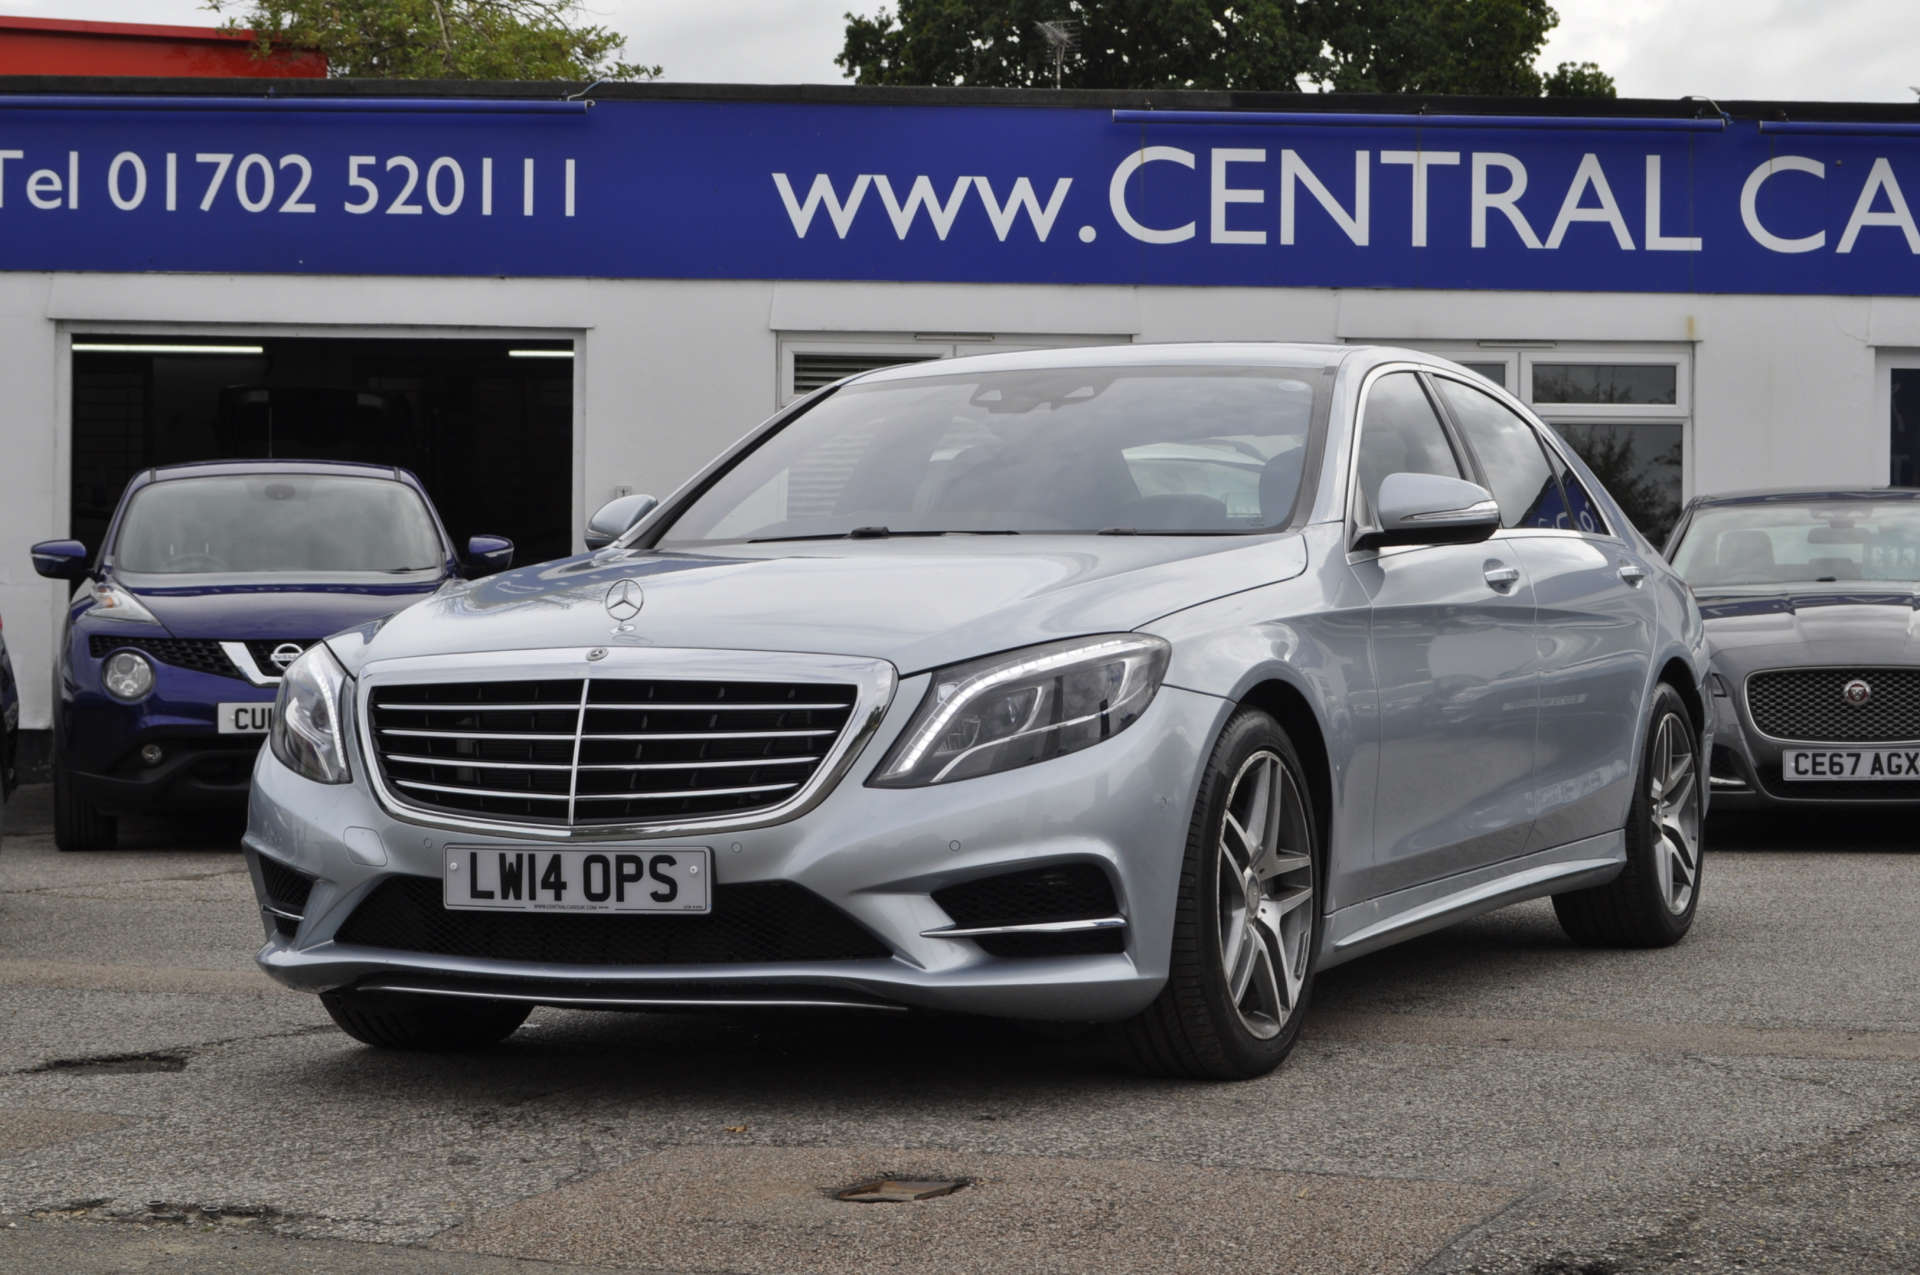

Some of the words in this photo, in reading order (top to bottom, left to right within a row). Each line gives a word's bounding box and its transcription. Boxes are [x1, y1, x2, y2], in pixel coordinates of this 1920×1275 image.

[0, 150, 79, 209] Tel
[107, 151, 316, 213] 01702
[344, 155, 576, 217] 520111
[1740, 155, 1920, 255] CA
[1794, 752, 1862, 776] CE67
[1870, 752, 1920, 776] AGX
[469, 851, 567, 902] LW14
[582, 853, 678, 903] OPS
